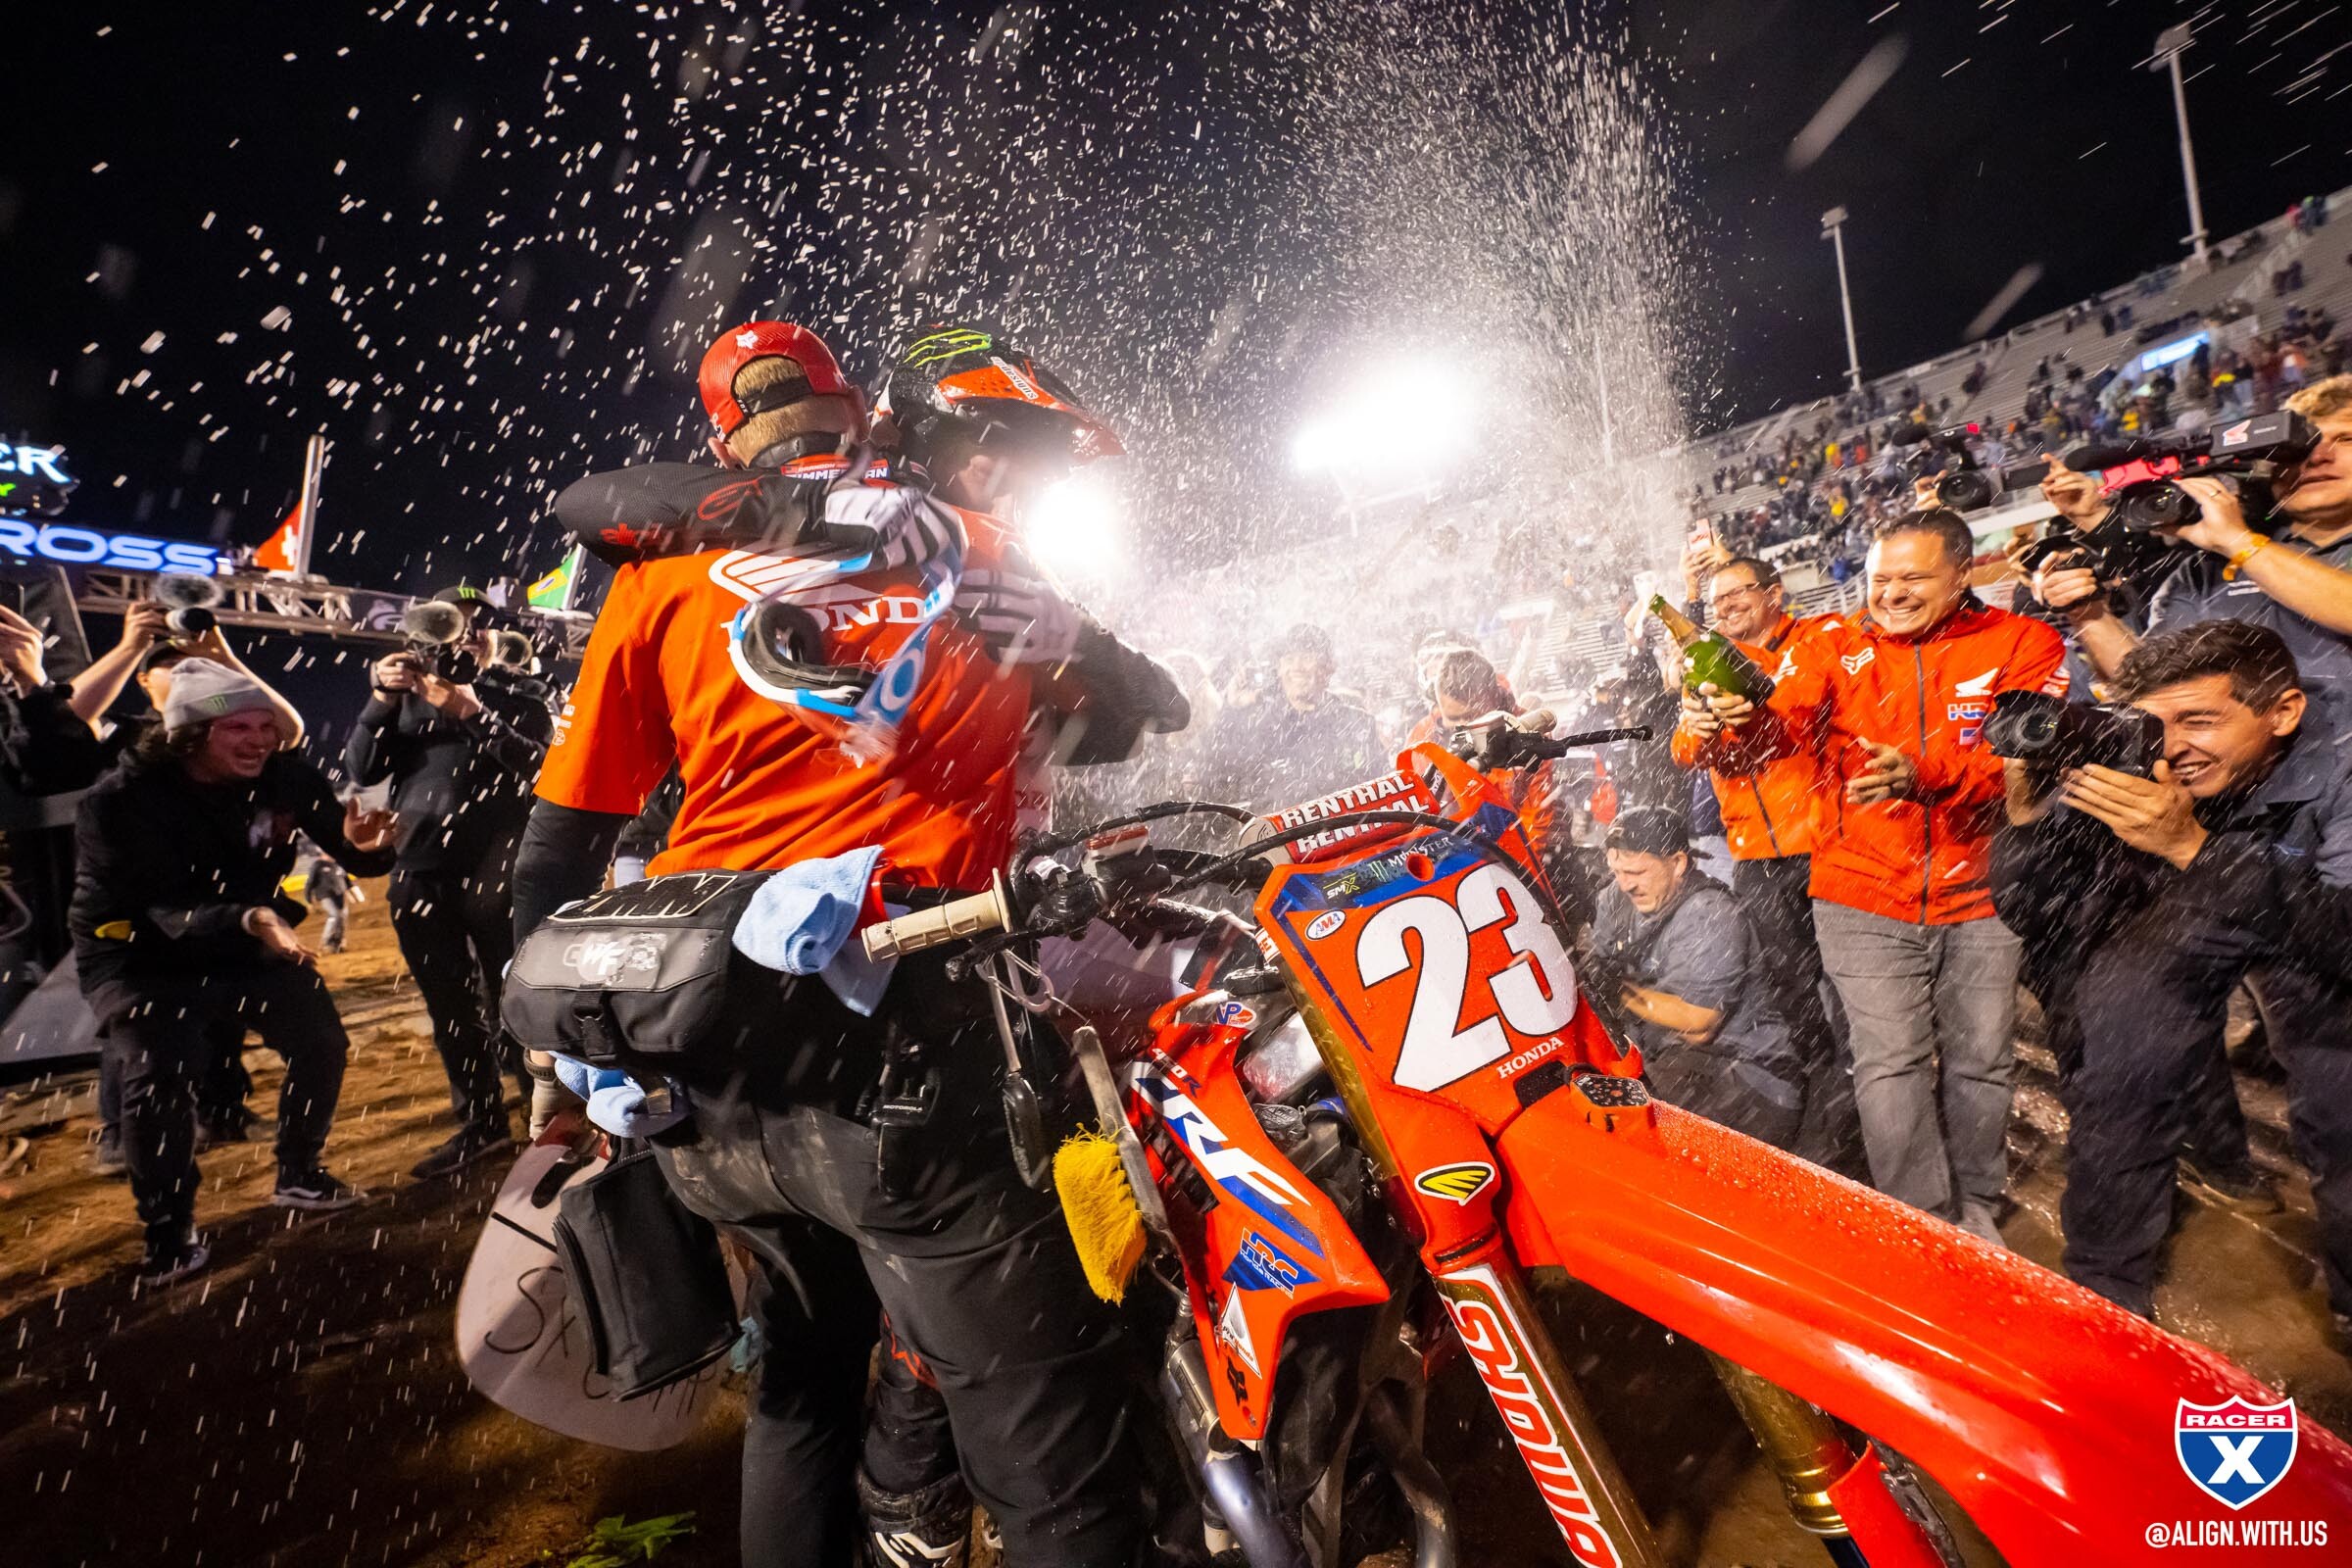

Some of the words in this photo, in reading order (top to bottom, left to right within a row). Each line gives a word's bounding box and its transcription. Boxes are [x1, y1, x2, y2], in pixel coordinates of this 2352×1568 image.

[1280, 774, 1415, 830] RENTHAL
[1315, 911, 1342, 937] AMA
[1357, 862, 1578, 1093] 23
[1216, 1004, 1243, 1025] VP
[1495, 1037, 1564, 1079] HONDA
[1240, 1227, 1298, 1294] HRC
